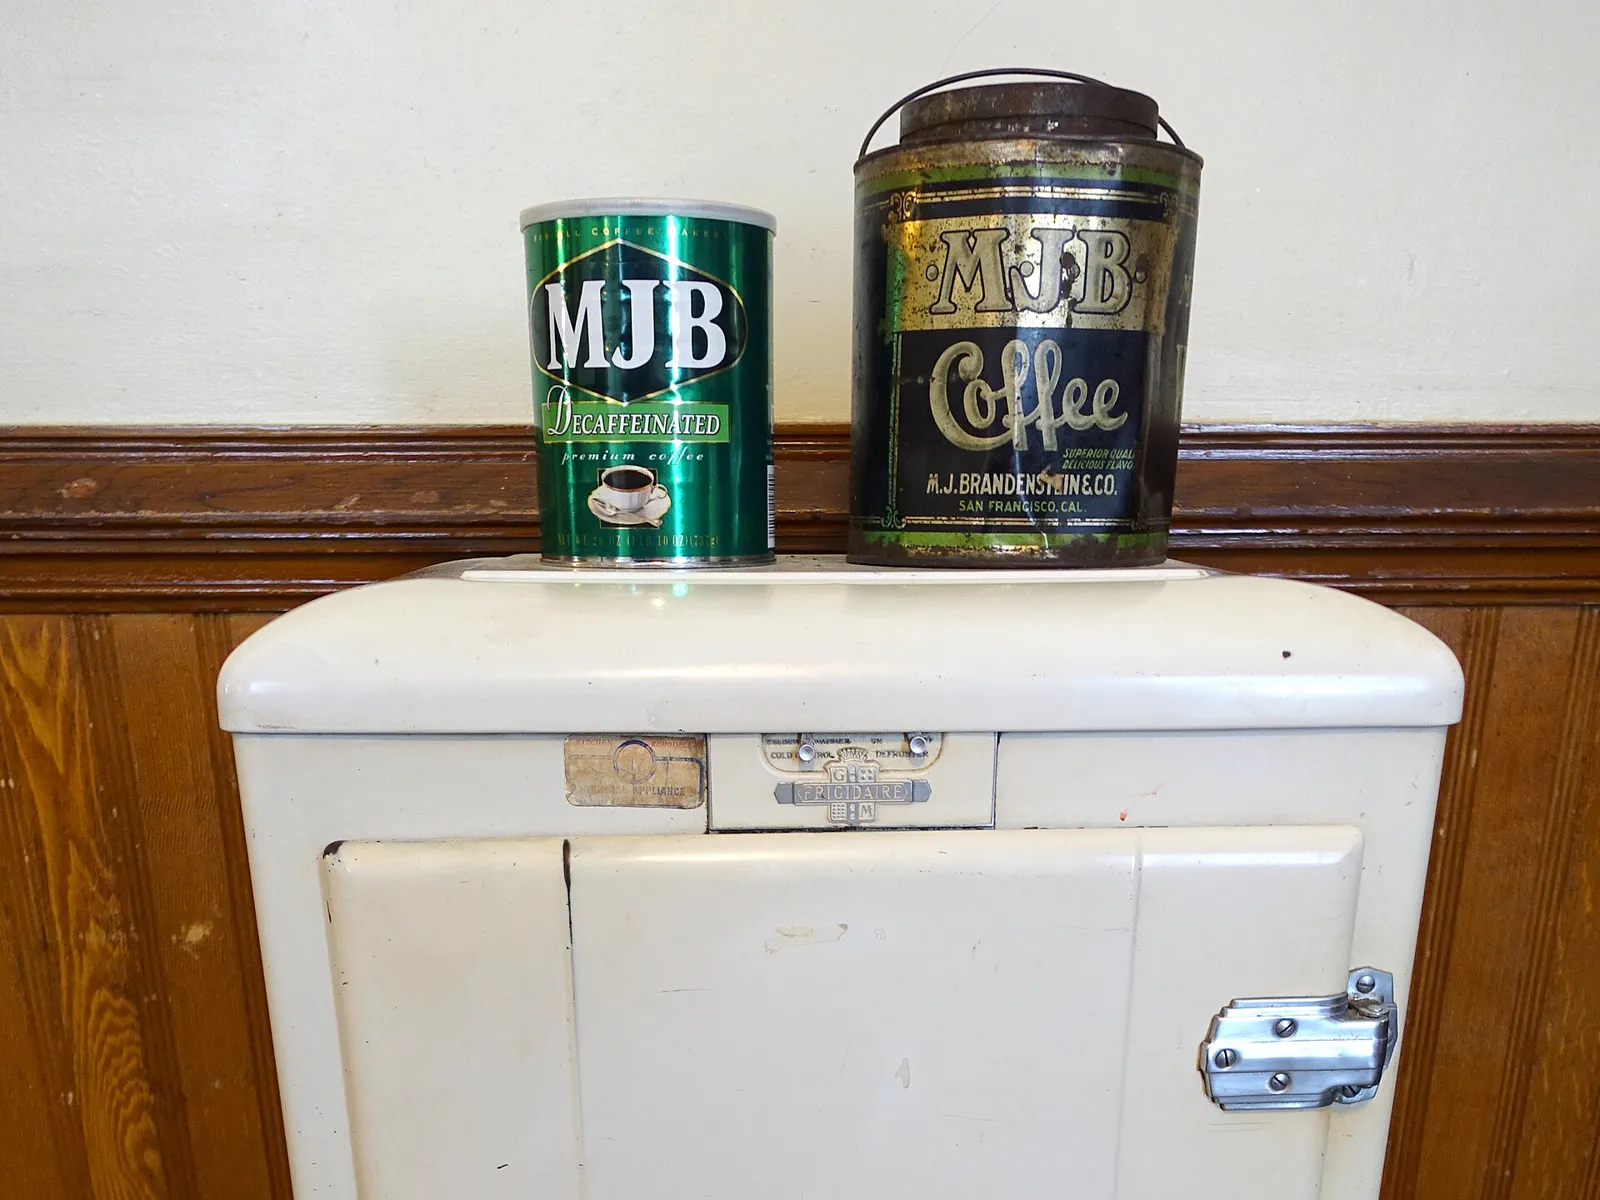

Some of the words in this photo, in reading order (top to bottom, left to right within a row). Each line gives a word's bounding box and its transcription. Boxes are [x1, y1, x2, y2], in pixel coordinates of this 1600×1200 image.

[929, 227, 1133, 315] MJB
[544, 279, 727, 370] MJB
[929, 339, 1128, 451] Coffee
[546, 385, 721, 436] DECAFFEINATED
[561, 449, 635, 466] premium
[649, 446, 705, 466] coffee
[1062, 447, 1108, 459] SUPERIOR
[1061, 459, 1104, 470] DELICIOUS
[1105, 460, 1135, 470] FLAVO
[958, 500, 984, 512] SAN
[988, 500, 1059, 514] FRANCISCO,
[1060, 500, 1087, 513] CAL.
[833, 769, 845, 782] G
[633, 785, 686, 797] APPLIANCE
[803, 785, 903, 801] FRIGIDAIRE
